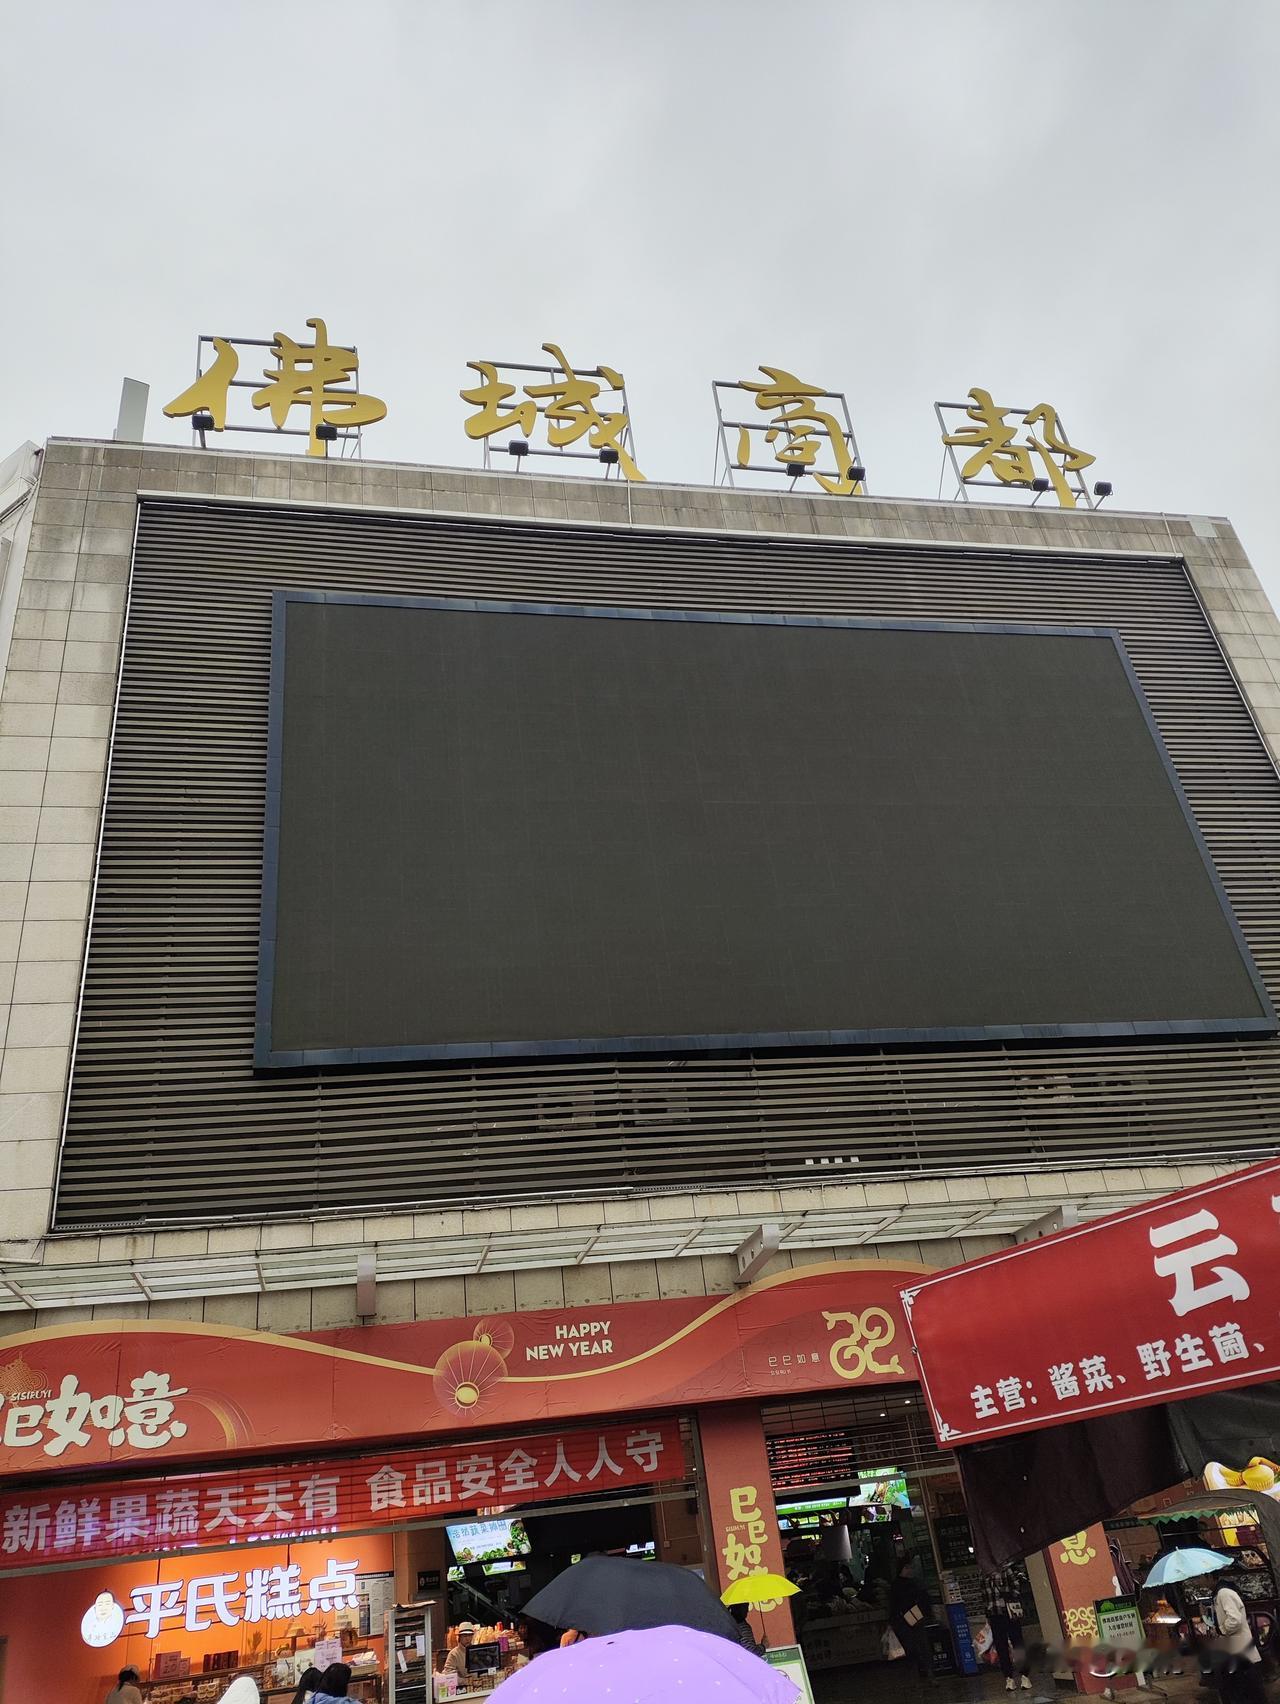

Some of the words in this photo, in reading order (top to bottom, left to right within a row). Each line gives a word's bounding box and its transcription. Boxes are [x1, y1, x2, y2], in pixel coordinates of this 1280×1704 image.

[1149, 1194, 1280, 1317] 云
[526, 1343, 564, 1361] NEW
[568, 1339, 613, 1357] YEAR
[555, 1320, 611, 1340] HAPPY
[0, 1370, 190, 1457] 巳如意
[2, 1473, 341, 1554] 新鲜果蔬天天有
[365, 1430, 664, 1513] 食品安全人人守
[126, 1558, 360, 1639] 平氏糕点
